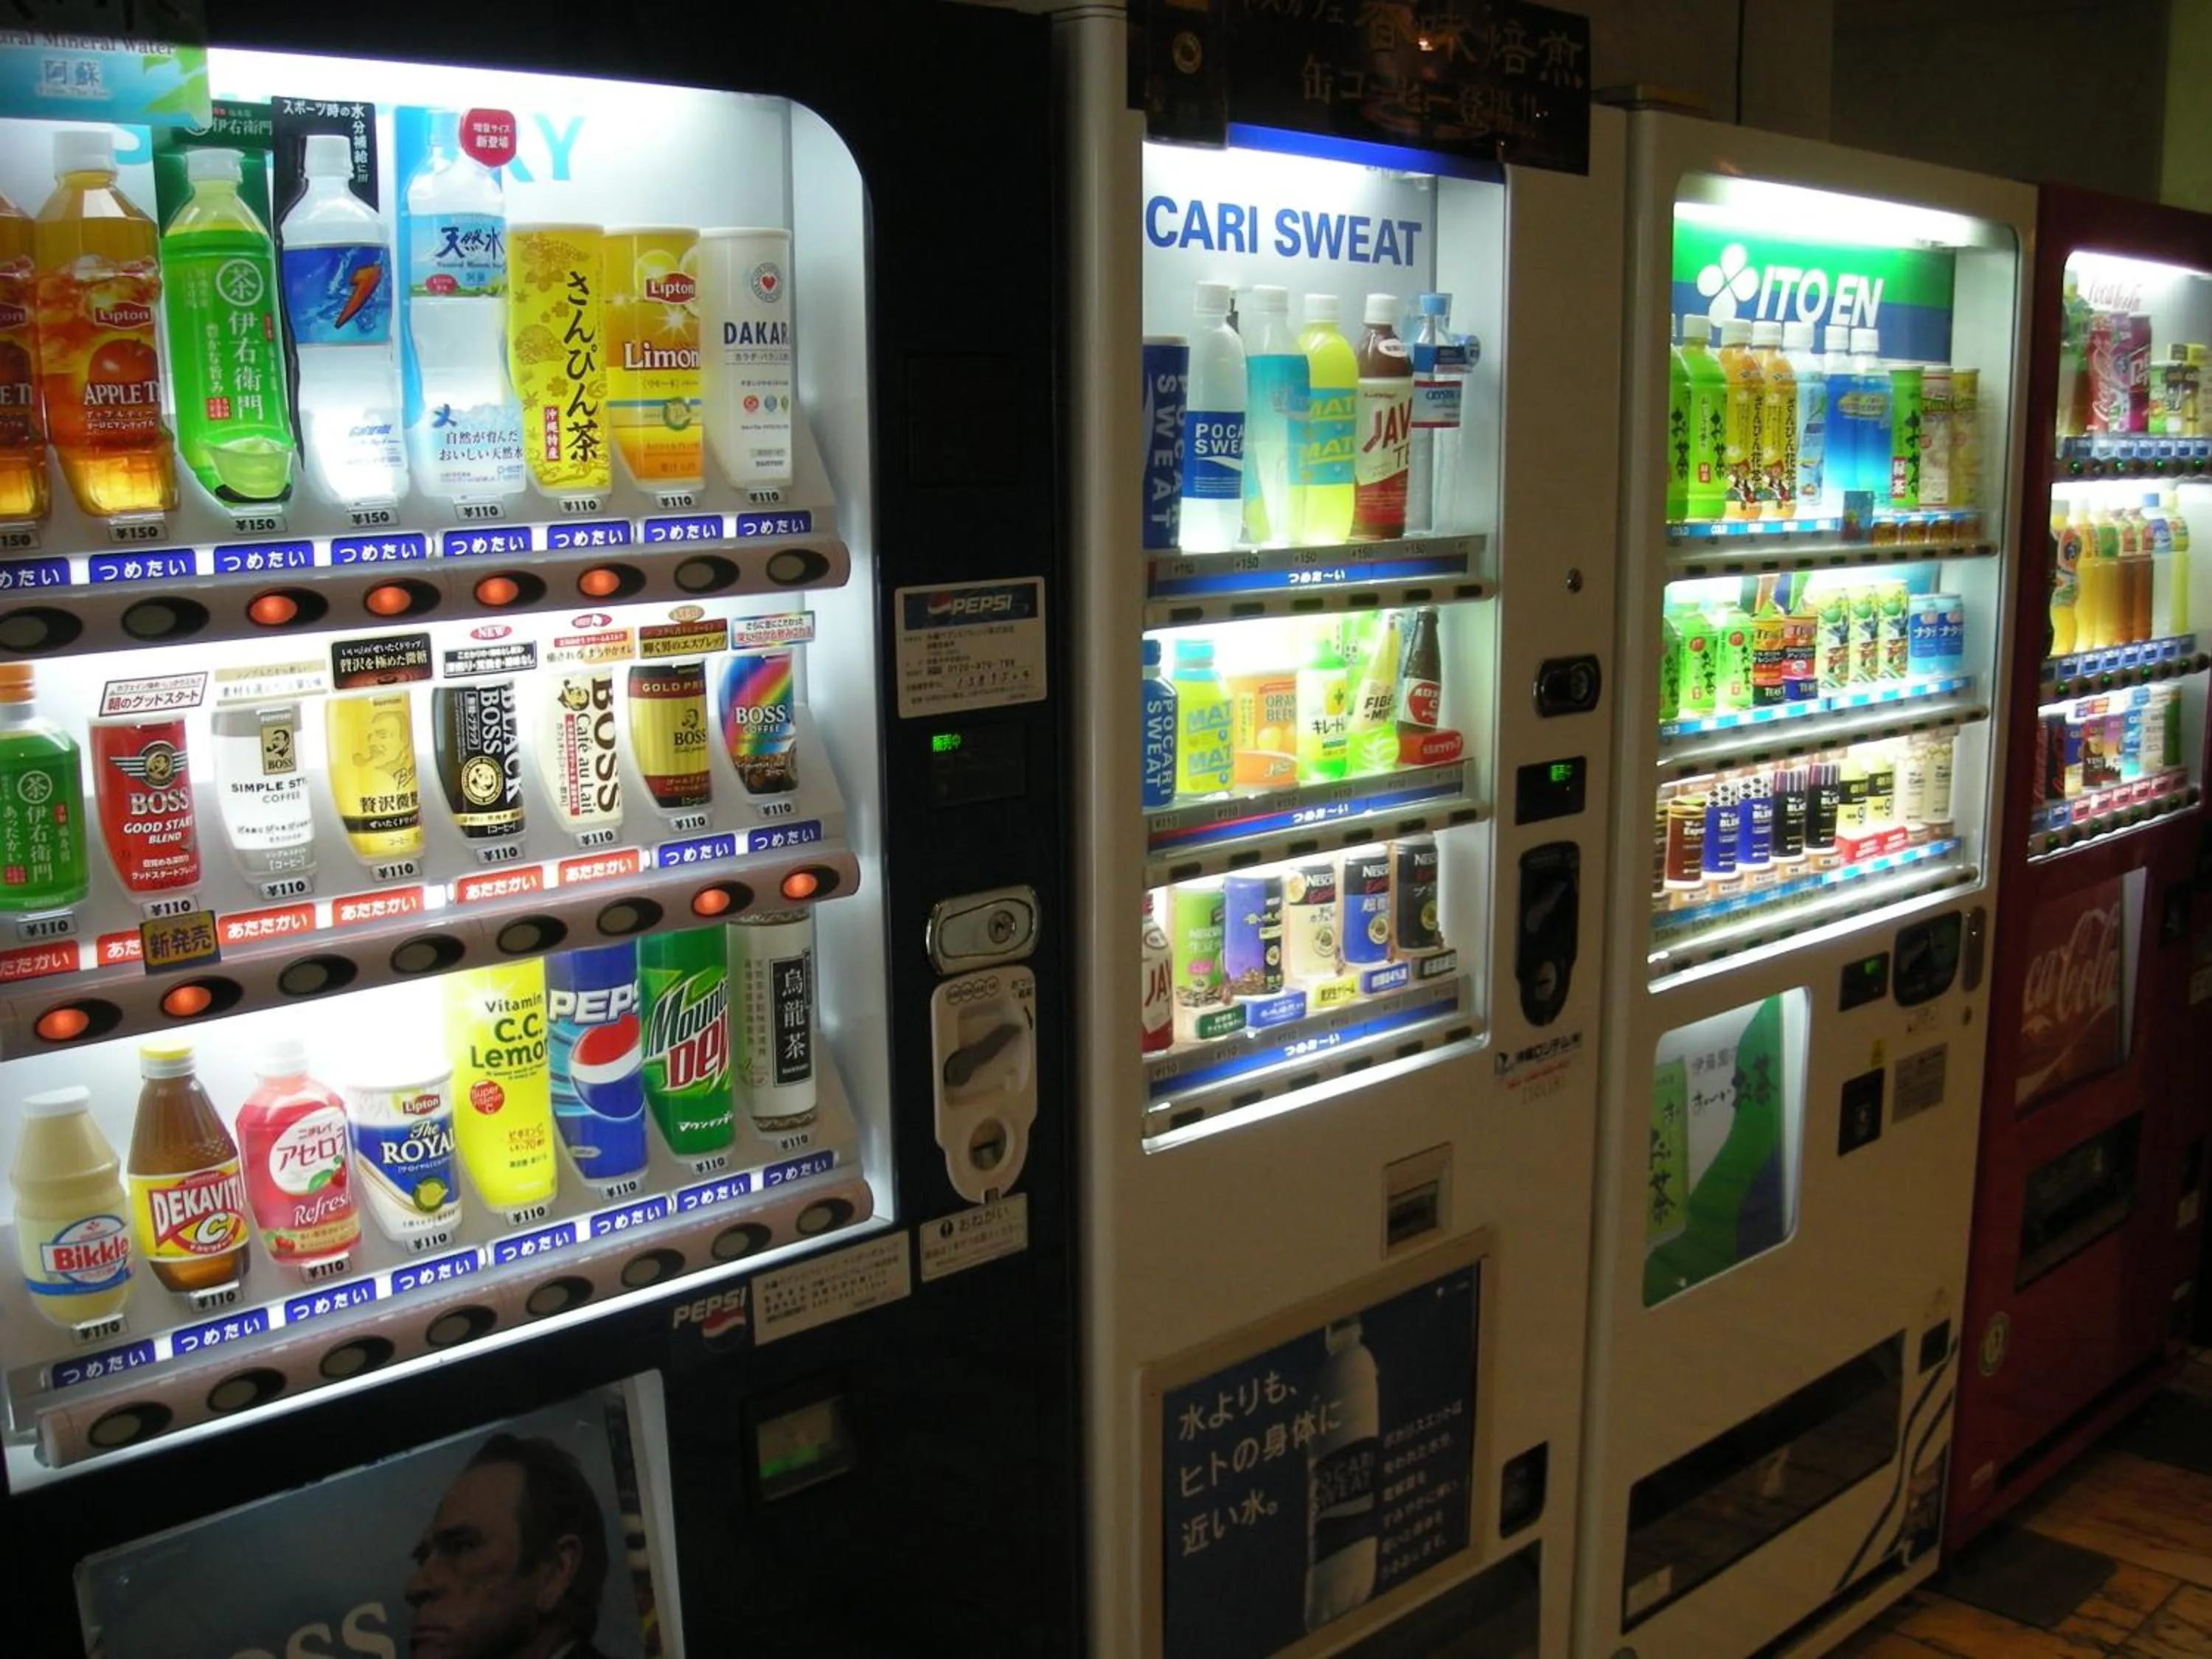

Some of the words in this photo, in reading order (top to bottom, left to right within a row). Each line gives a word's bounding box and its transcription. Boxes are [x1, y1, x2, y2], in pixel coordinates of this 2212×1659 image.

[122, 36, 177, 54] Water
[475, 135, 509, 148] 新登場
[1144, 195, 1257, 254] CARI
[1273, 208, 1422, 268] SWEAT
[434, 226, 505, 260] 天然水
[650, 281, 695, 298] Lipton
[1756, 265, 1829, 324] ITO
[1829, 273, 1885, 328] EN
[100, 309, 150, 323] Lipton
[228, 310, 264, 421] 伊右衛門
[84, 383, 142, 406] APPLE
[1151, 374, 1177, 529] SWEAT
[563, 498, 597, 512] ¥110
[659, 495, 692, 508] ¥110
[748, 490, 780, 504] ¥110
[351, 510, 390, 525] ¥150
[462, 504, 498, 518] ¥110
[114, 524, 158, 540] ¥150
[234, 518, 276, 532] ¥150
[650, 523, 717, 542] つめたい
[742, 518, 806, 537] つめたい
[450, 535, 526, 556] つめたい
[554, 529, 624, 549] つめたい
[223, 550, 307, 571] つめたい
[339, 543, 418, 562] つめたい
[98, 560, 187, 580] つめたい
[950, 594, 1013, 616] PEPSI
[477, 625, 505, 639] NEW
[641, 683, 681, 693] GOLD
[480, 689, 502, 755] BOSS
[734, 705, 787, 724] BOSS
[575, 713, 592, 754] Café
[742, 723, 780, 734] COFFEE
[592, 679, 619, 813] BOSS
[1146, 700, 1162, 787] SWEAT
[1161, 698, 1174, 795] POCARI
[268, 757, 293, 770] BOSS
[579, 757, 590, 779] au
[231, 782, 283, 793] SIMPLE
[129, 787, 189, 816] BOSS
[580, 782, 594, 815] Lait
[762, 803, 793, 817] ¥110
[124, 821, 162, 834] GOOD
[675, 815, 706, 830] ¥110
[27, 805, 53, 884] 伊右衛門
[148, 832, 182, 844] BLEND
[581, 830, 614, 845] ¥110
[754, 827, 815, 850] つめたい
[484, 846, 518, 861] ¥110
[665, 843, 730, 866] つめたい
[378, 863, 414, 878] ¥110
[566, 858, 634, 881] あたたかい
[266, 880, 307, 898] ¥110
[465, 877, 538, 900] あたたかい
[150, 900, 192, 916] ¥110
[341, 896, 417, 922] あたたかい
[25, 919, 69, 936] ¥110
[226, 914, 308, 939] あたたかい
[149, 923, 214, 959] 新発売
[781, 968, 807, 1060] 烏龍茶
[495, 1012, 543, 1043] C.C.
[406, 1095, 439, 1113] Lipton
[409, 1119, 440, 1139] The
[780, 1135, 809, 1151] ¥110
[695, 1156, 726, 1174] ¥110
[769, 1159, 827, 1183] つめたい
[605, 1179, 637, 1197] ¥110
[684, 1182, 745, 1209] つめたい
[512, 1206, 546, 1224] ¥110
[597, 1206, 661, 1236] つめたい
[195, 1211, 228, 1245] C
[411, 1232, 447, 1251] ¥110
[502, 1231, 571, 1263] つめたい
[52, 1235, 131, 1271] Bikkle
[307, 1260, 345, 1279] ¥110
[398, 1259, 471, 1290] つめたい
[195, 1290, 237, 1309] ¥110
[292, 1287, 369, 1321] つめたい
[672, 1287, 747, 1330] PEPSI
[78, 1321, 121, 1340] ¥110
[180, 1317, 261, 1352] つめたい
[60, 1349, 147, 1385] つめたい
[1178, 1369, 1298, 1441] 水よりも、
[1178, 1399, 1343, 1498] ヒトの身体に
[1182, 1489, 1279, 1558] 近い水。
